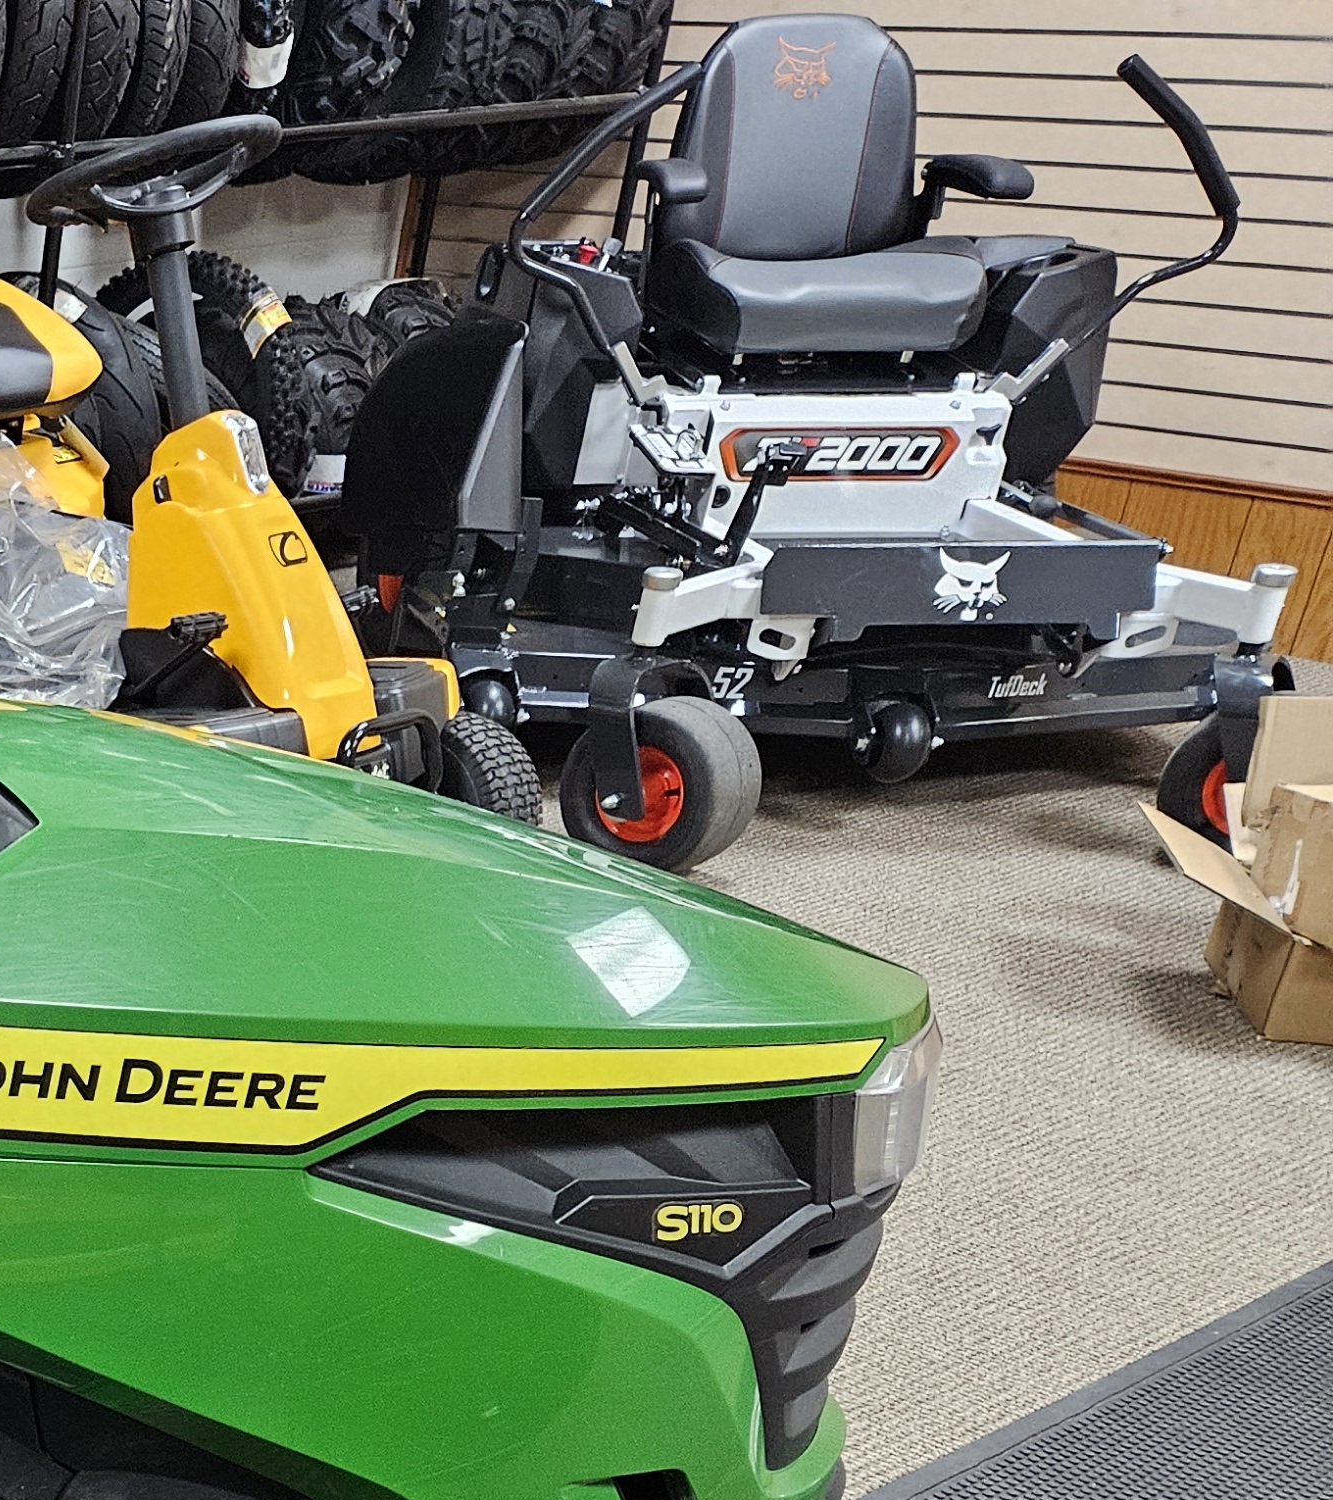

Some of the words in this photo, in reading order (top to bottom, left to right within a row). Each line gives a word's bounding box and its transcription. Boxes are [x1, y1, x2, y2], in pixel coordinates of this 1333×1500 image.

[712, 667, 754, 699] 52
[987, 673, 1048, 699] TufDeck
[115, 1058, 326, 1111] DEERE
[656, 1203, 743, 1242] S110
